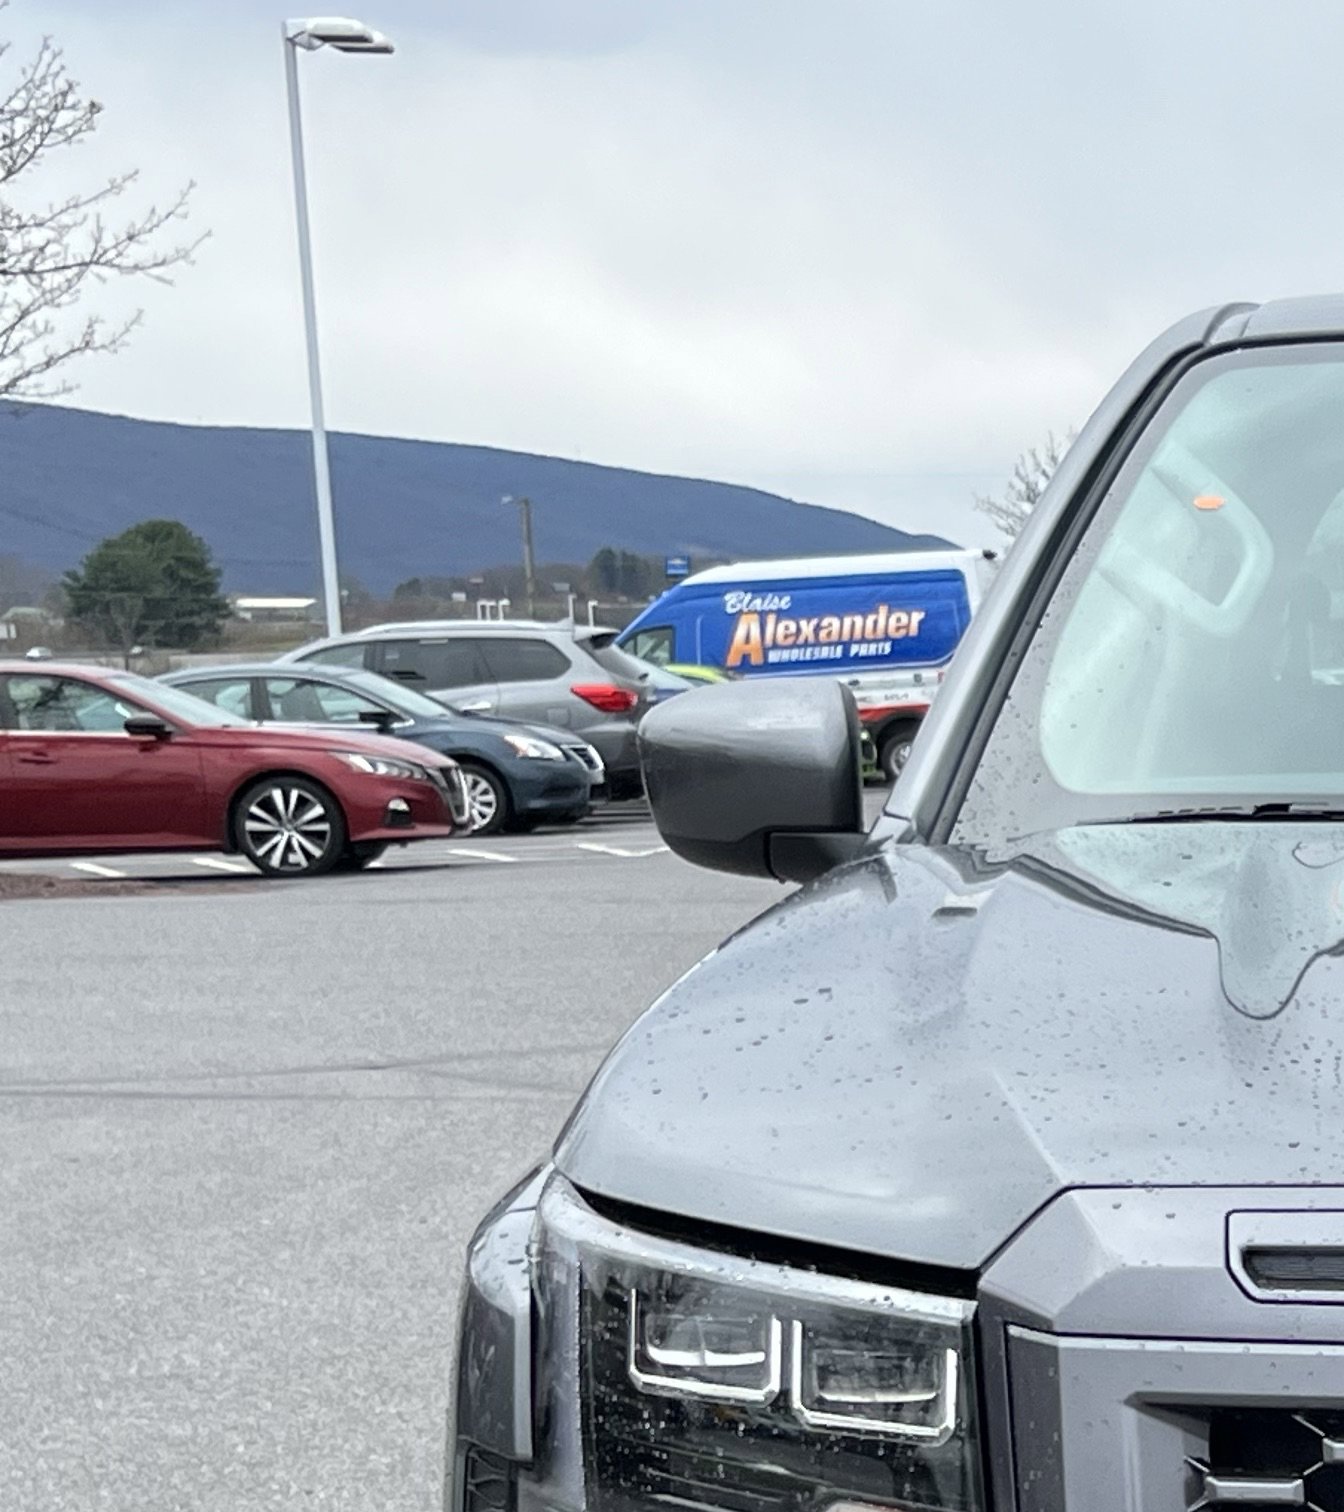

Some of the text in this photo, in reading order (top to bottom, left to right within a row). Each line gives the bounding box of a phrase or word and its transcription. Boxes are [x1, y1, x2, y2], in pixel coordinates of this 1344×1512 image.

[724, 591, 792, 614] Blaise
[726, 604, 926, 667] Alexander
[767, 641, 892, 664] WHOLESALE PARTS
